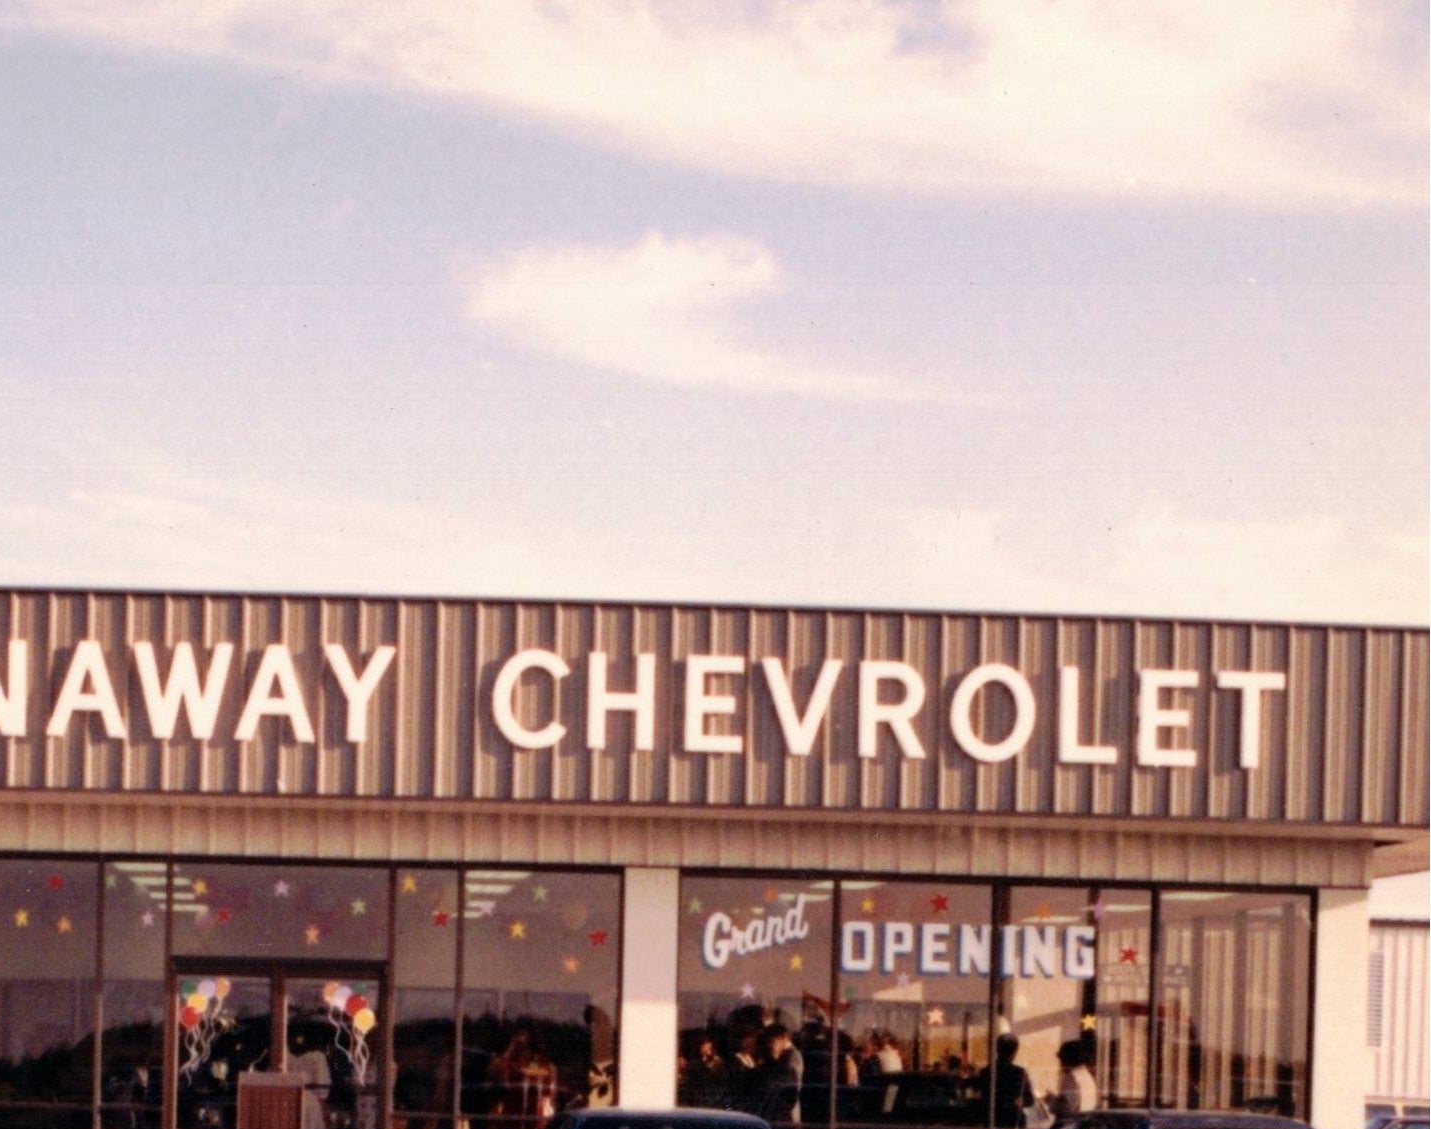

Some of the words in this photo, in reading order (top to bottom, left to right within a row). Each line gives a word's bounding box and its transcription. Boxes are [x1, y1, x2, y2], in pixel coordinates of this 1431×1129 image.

[492, 649, 1286, 769] CHEVROLET
[703, 893, 809, 969] Grand
[840, 920, 1096, 979] OPENING
